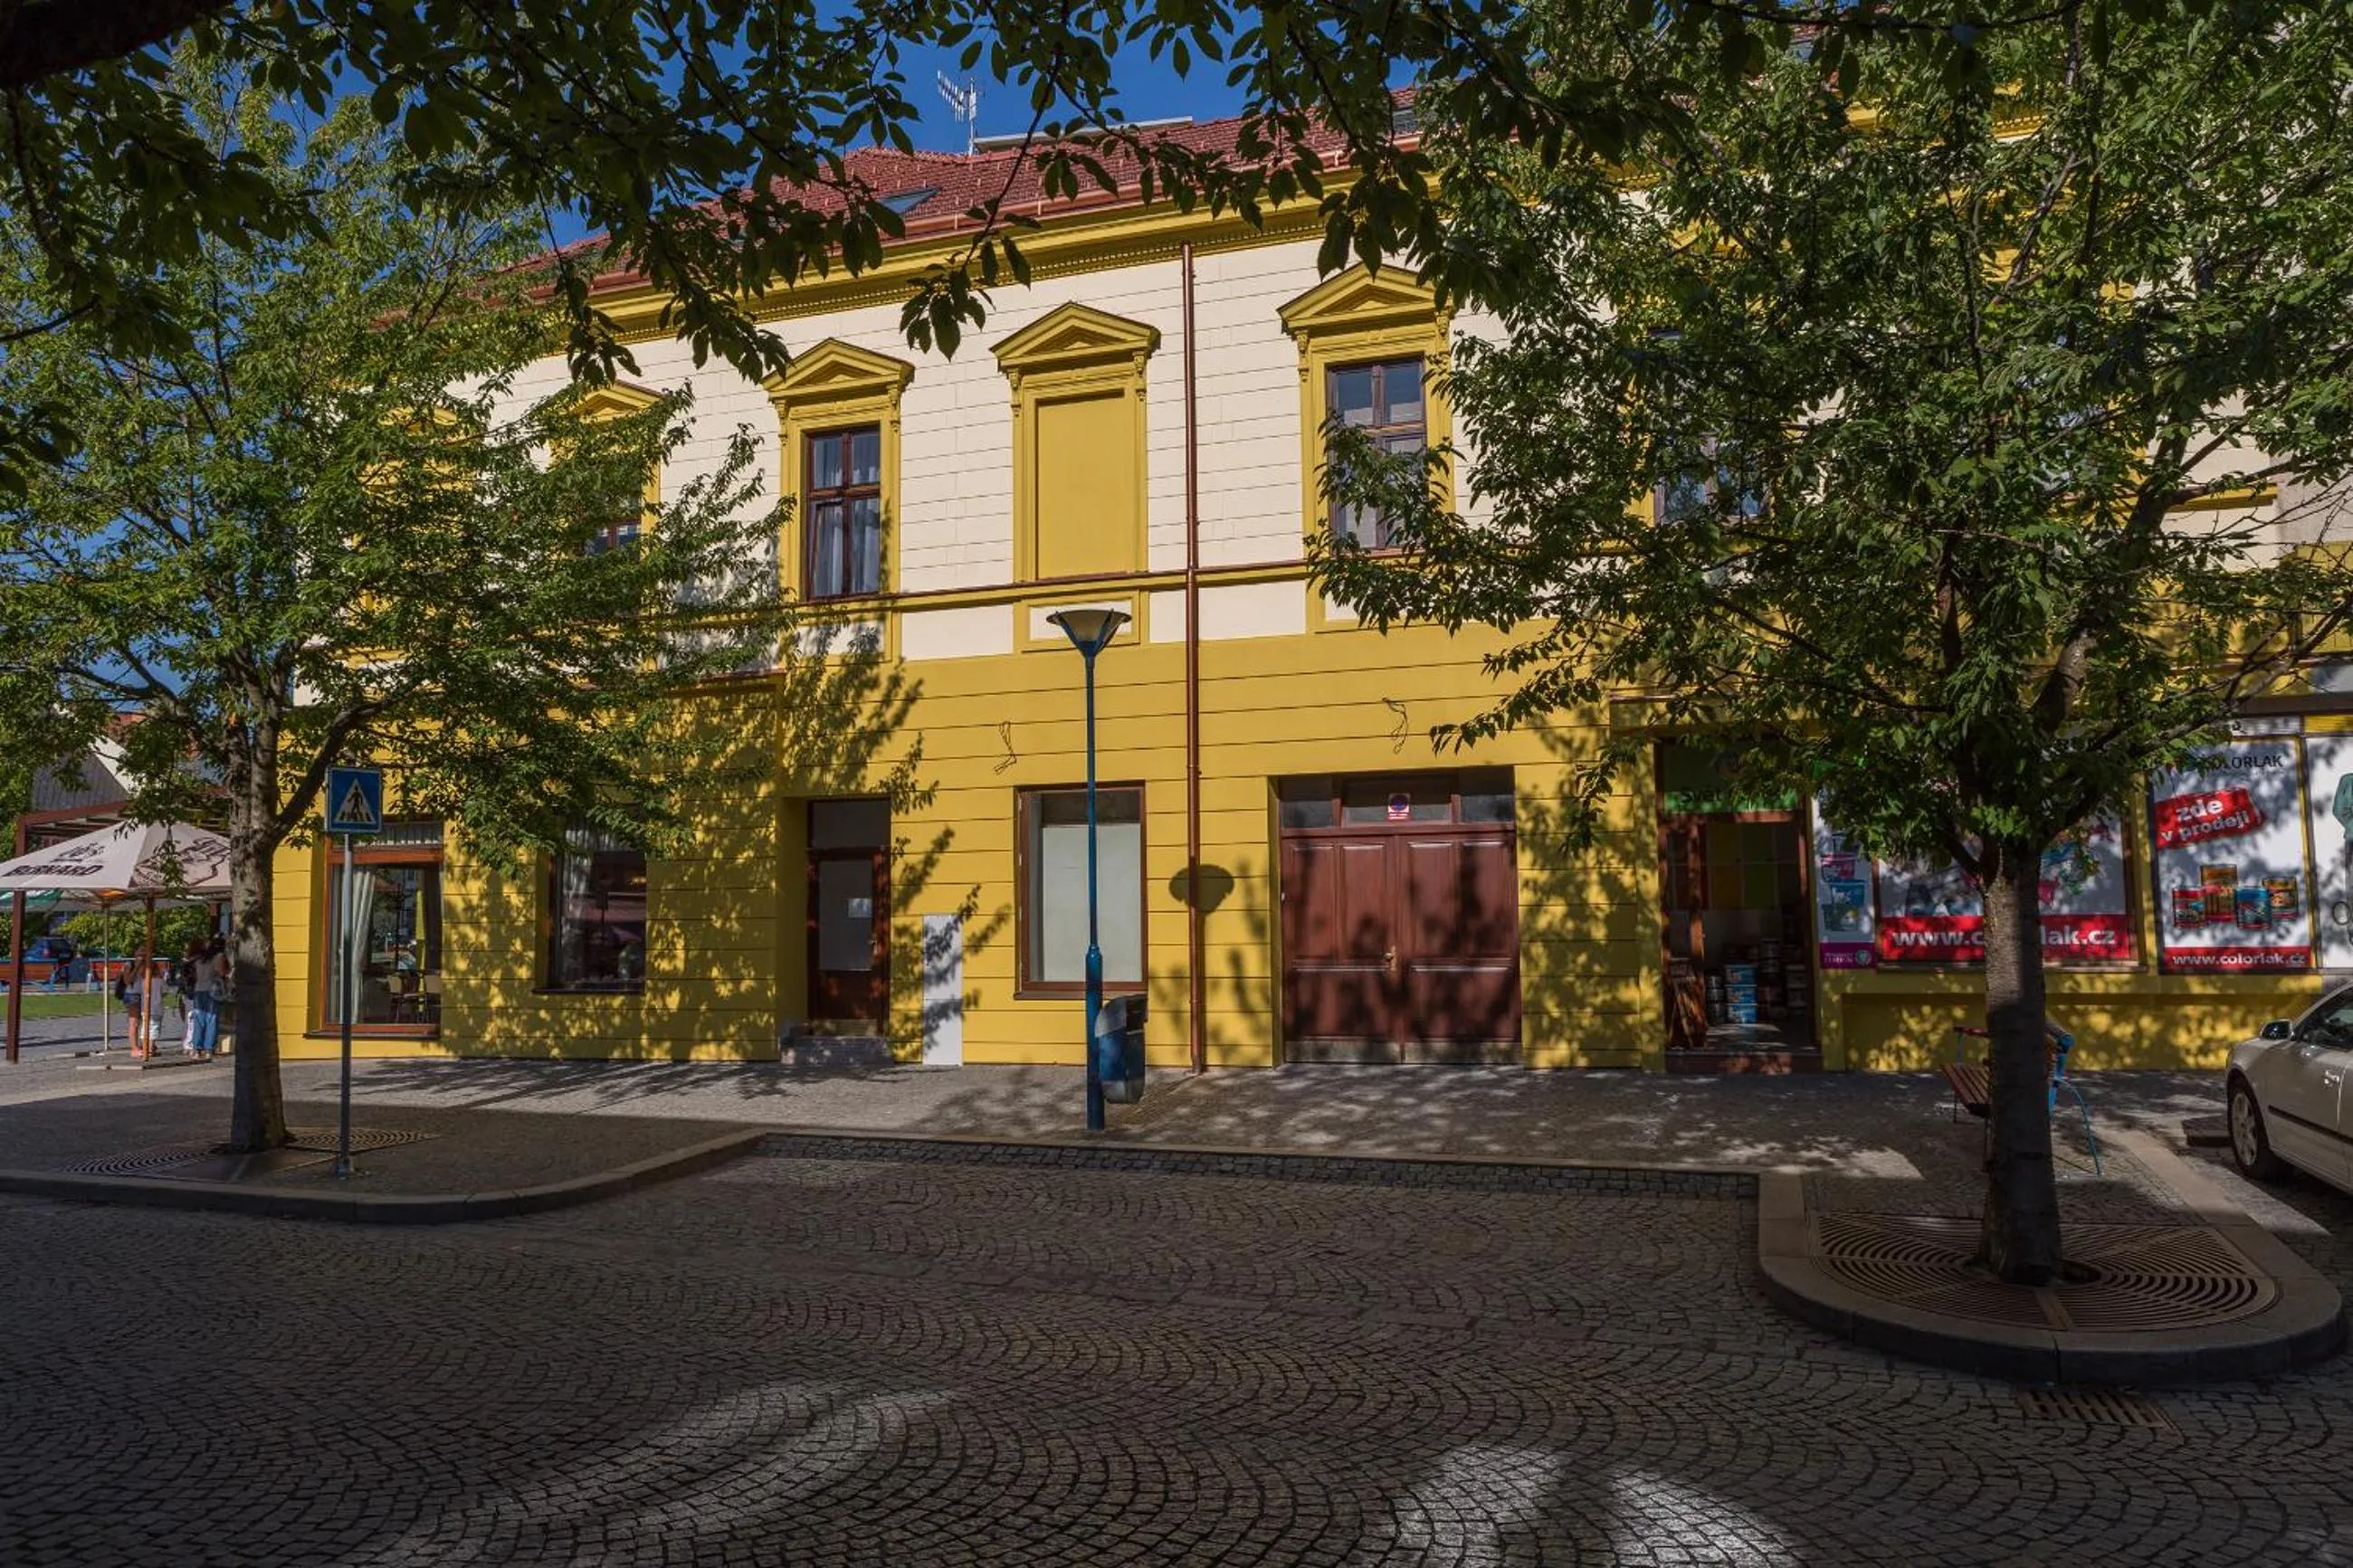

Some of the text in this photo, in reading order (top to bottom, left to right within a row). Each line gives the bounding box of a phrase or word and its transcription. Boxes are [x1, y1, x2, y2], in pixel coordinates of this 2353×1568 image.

[2203, 754, 2283, 769] OLORLAK
[2176, 799, 2224, 822] zde
[2161, 811, 2250, 841] v prodeji
[2, 864, 103, 877] BERNARD
[1892, 926, 2116, 946] www.clak.cz
[2172, 952, 2306, 965] www.colorlak.cz
